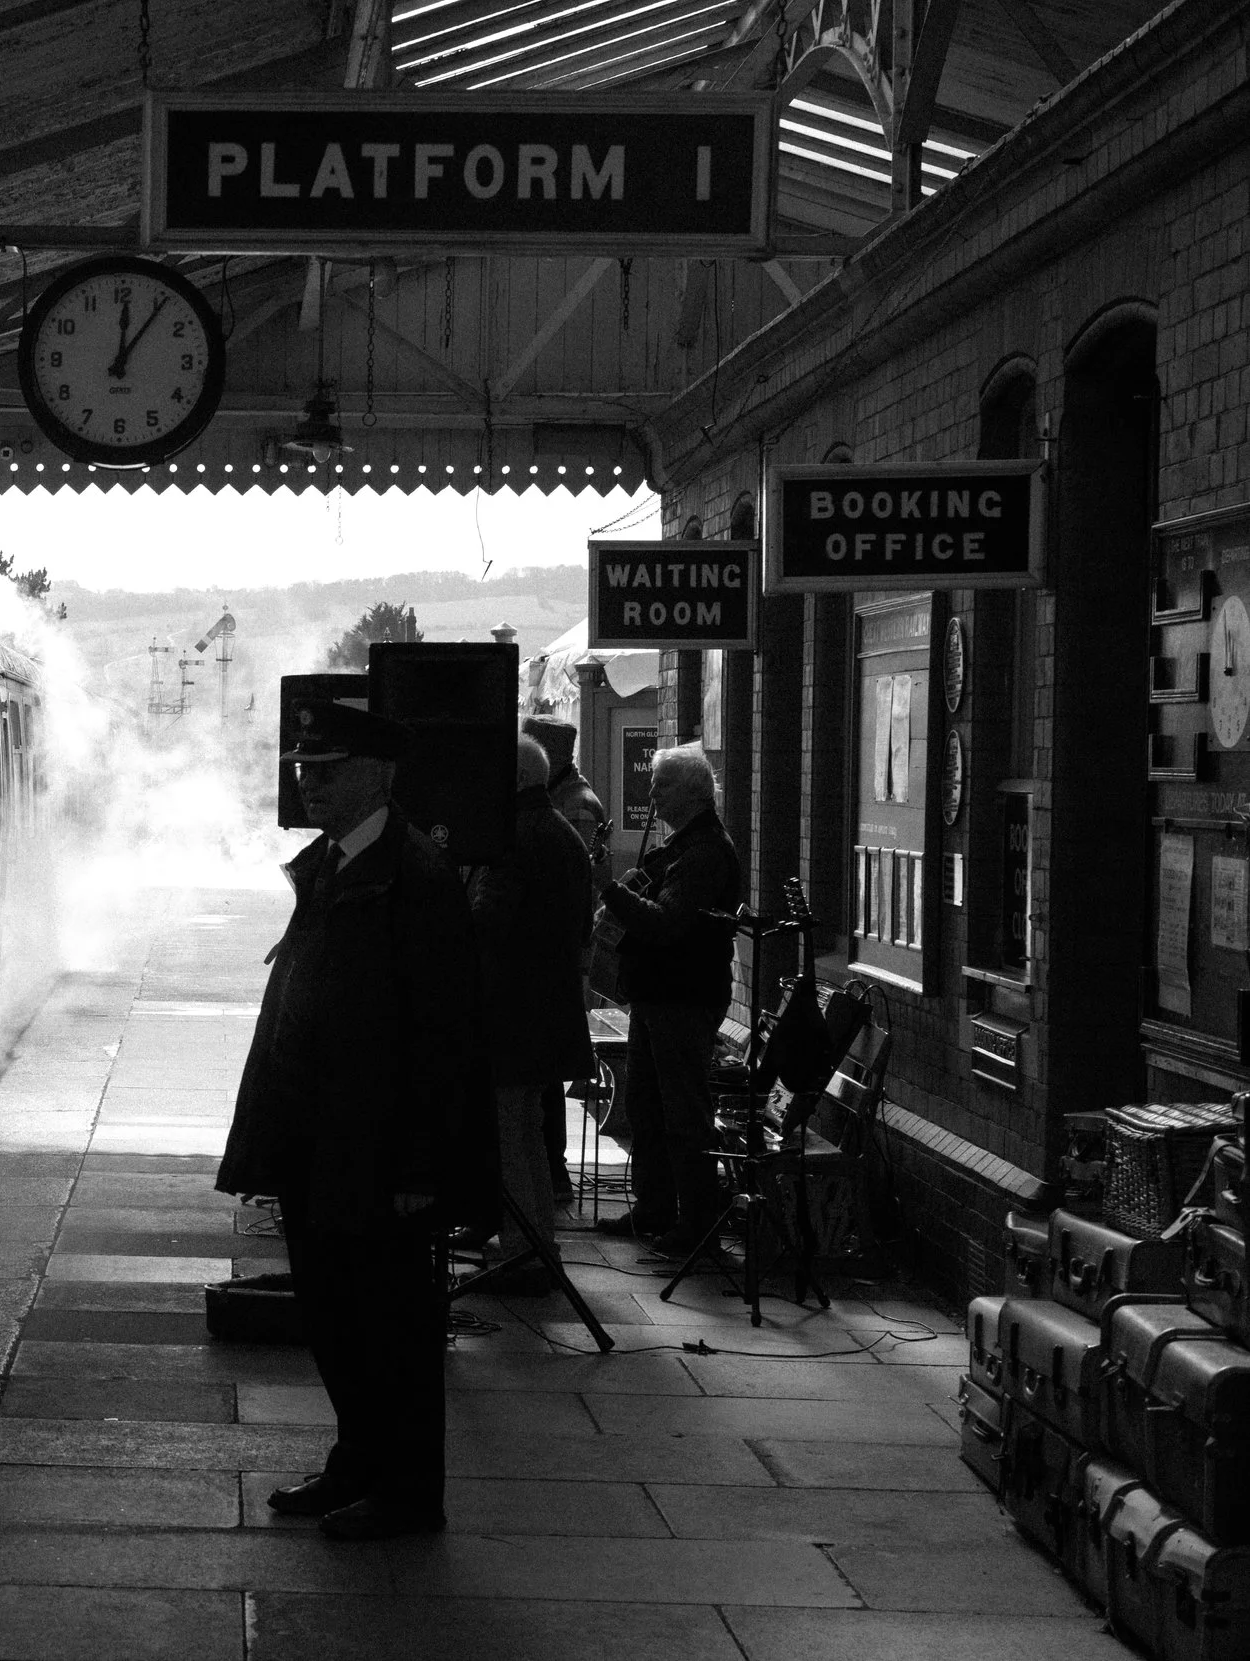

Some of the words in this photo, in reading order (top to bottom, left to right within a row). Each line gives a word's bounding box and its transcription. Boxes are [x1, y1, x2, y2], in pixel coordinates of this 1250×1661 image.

[207, 141, 626, 200] PLATFORM
[84, 294, 97, 312] 11
[113, 286, 132, 304] 12
[57, 318, 76, 336] 10
[172, 320, 185, 338] 2
[50, 351, 63, 368] 9
[181, 353, 193, 371] 3
[59, 384, 71, 401] 8
[170, 386, 184, 403] 4
[82, 408, 94, 425] 7
[146, 410, 159, 427] 5
[113, 418, 126, 435] 6
[809, 489, 1002, 519] BOOKING
[825, 532, 986, 561] OFFICE
[606, 563, 742, 588] WAITING
[623, 601, 722, 626] ROOM
